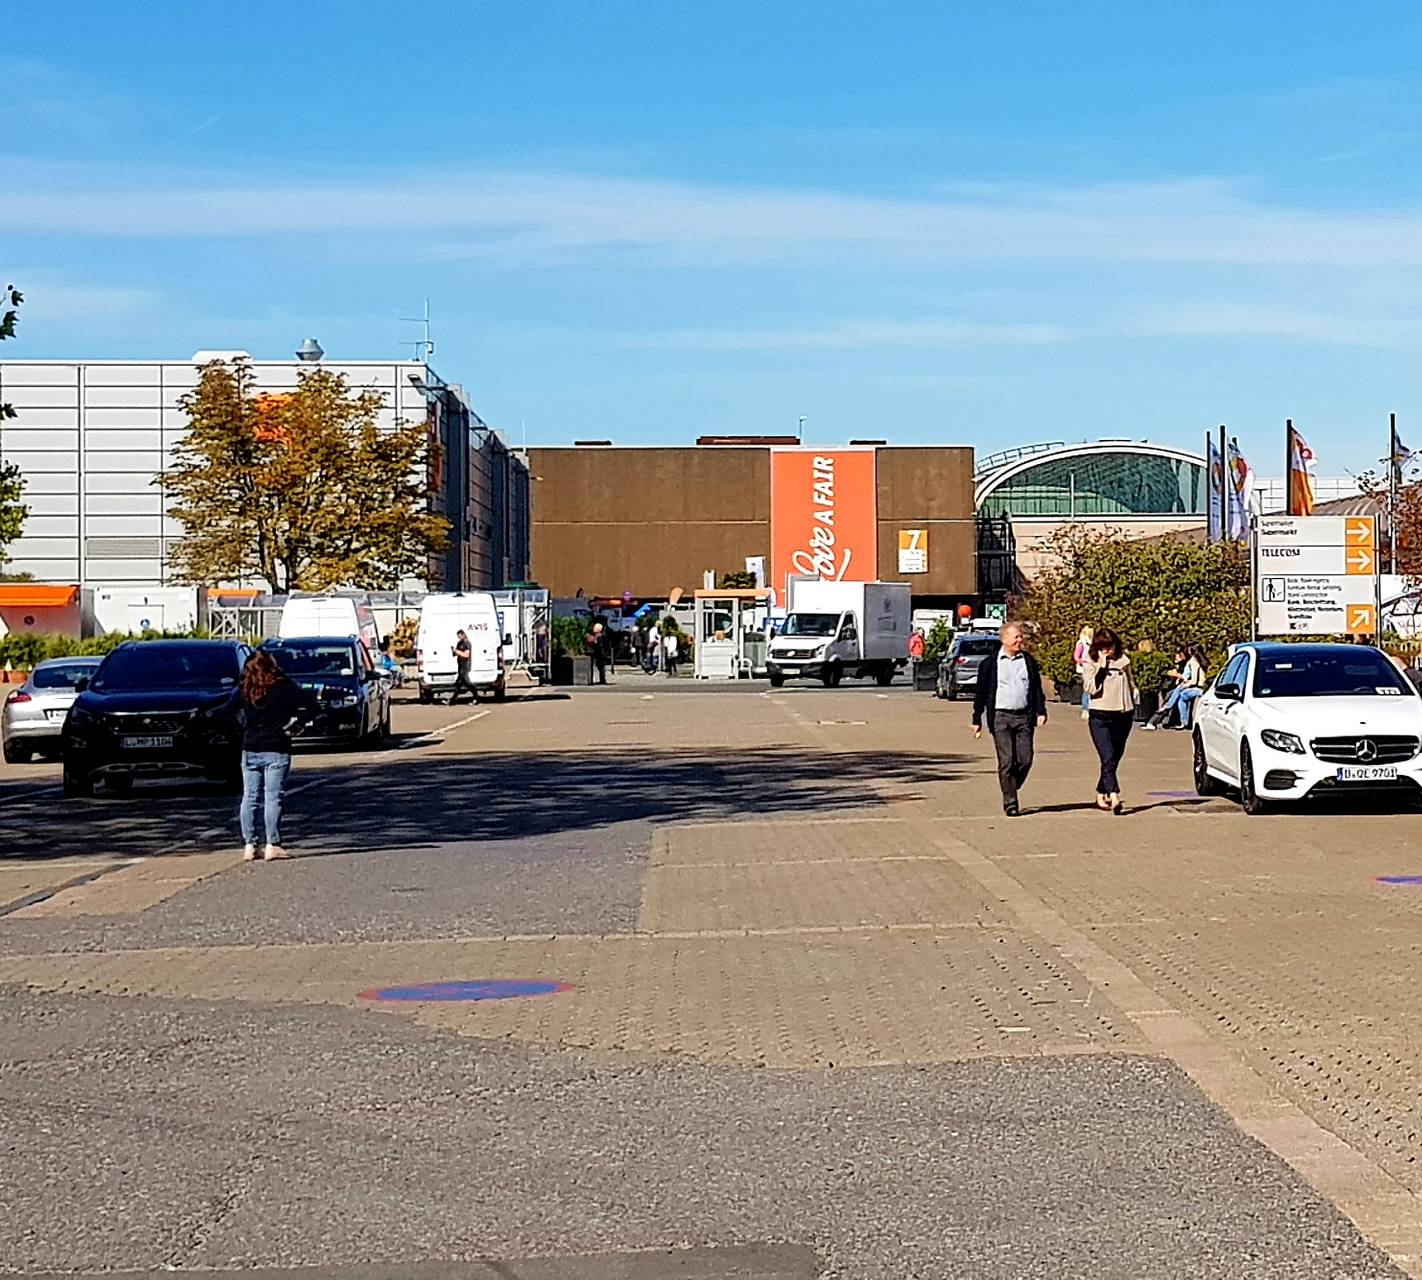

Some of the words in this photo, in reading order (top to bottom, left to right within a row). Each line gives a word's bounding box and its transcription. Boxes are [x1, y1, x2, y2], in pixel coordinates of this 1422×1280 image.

[813, 456, 834, 506] FAIR
[813, 510, 834, 526] A
[904, 530, 921, 550] 7
